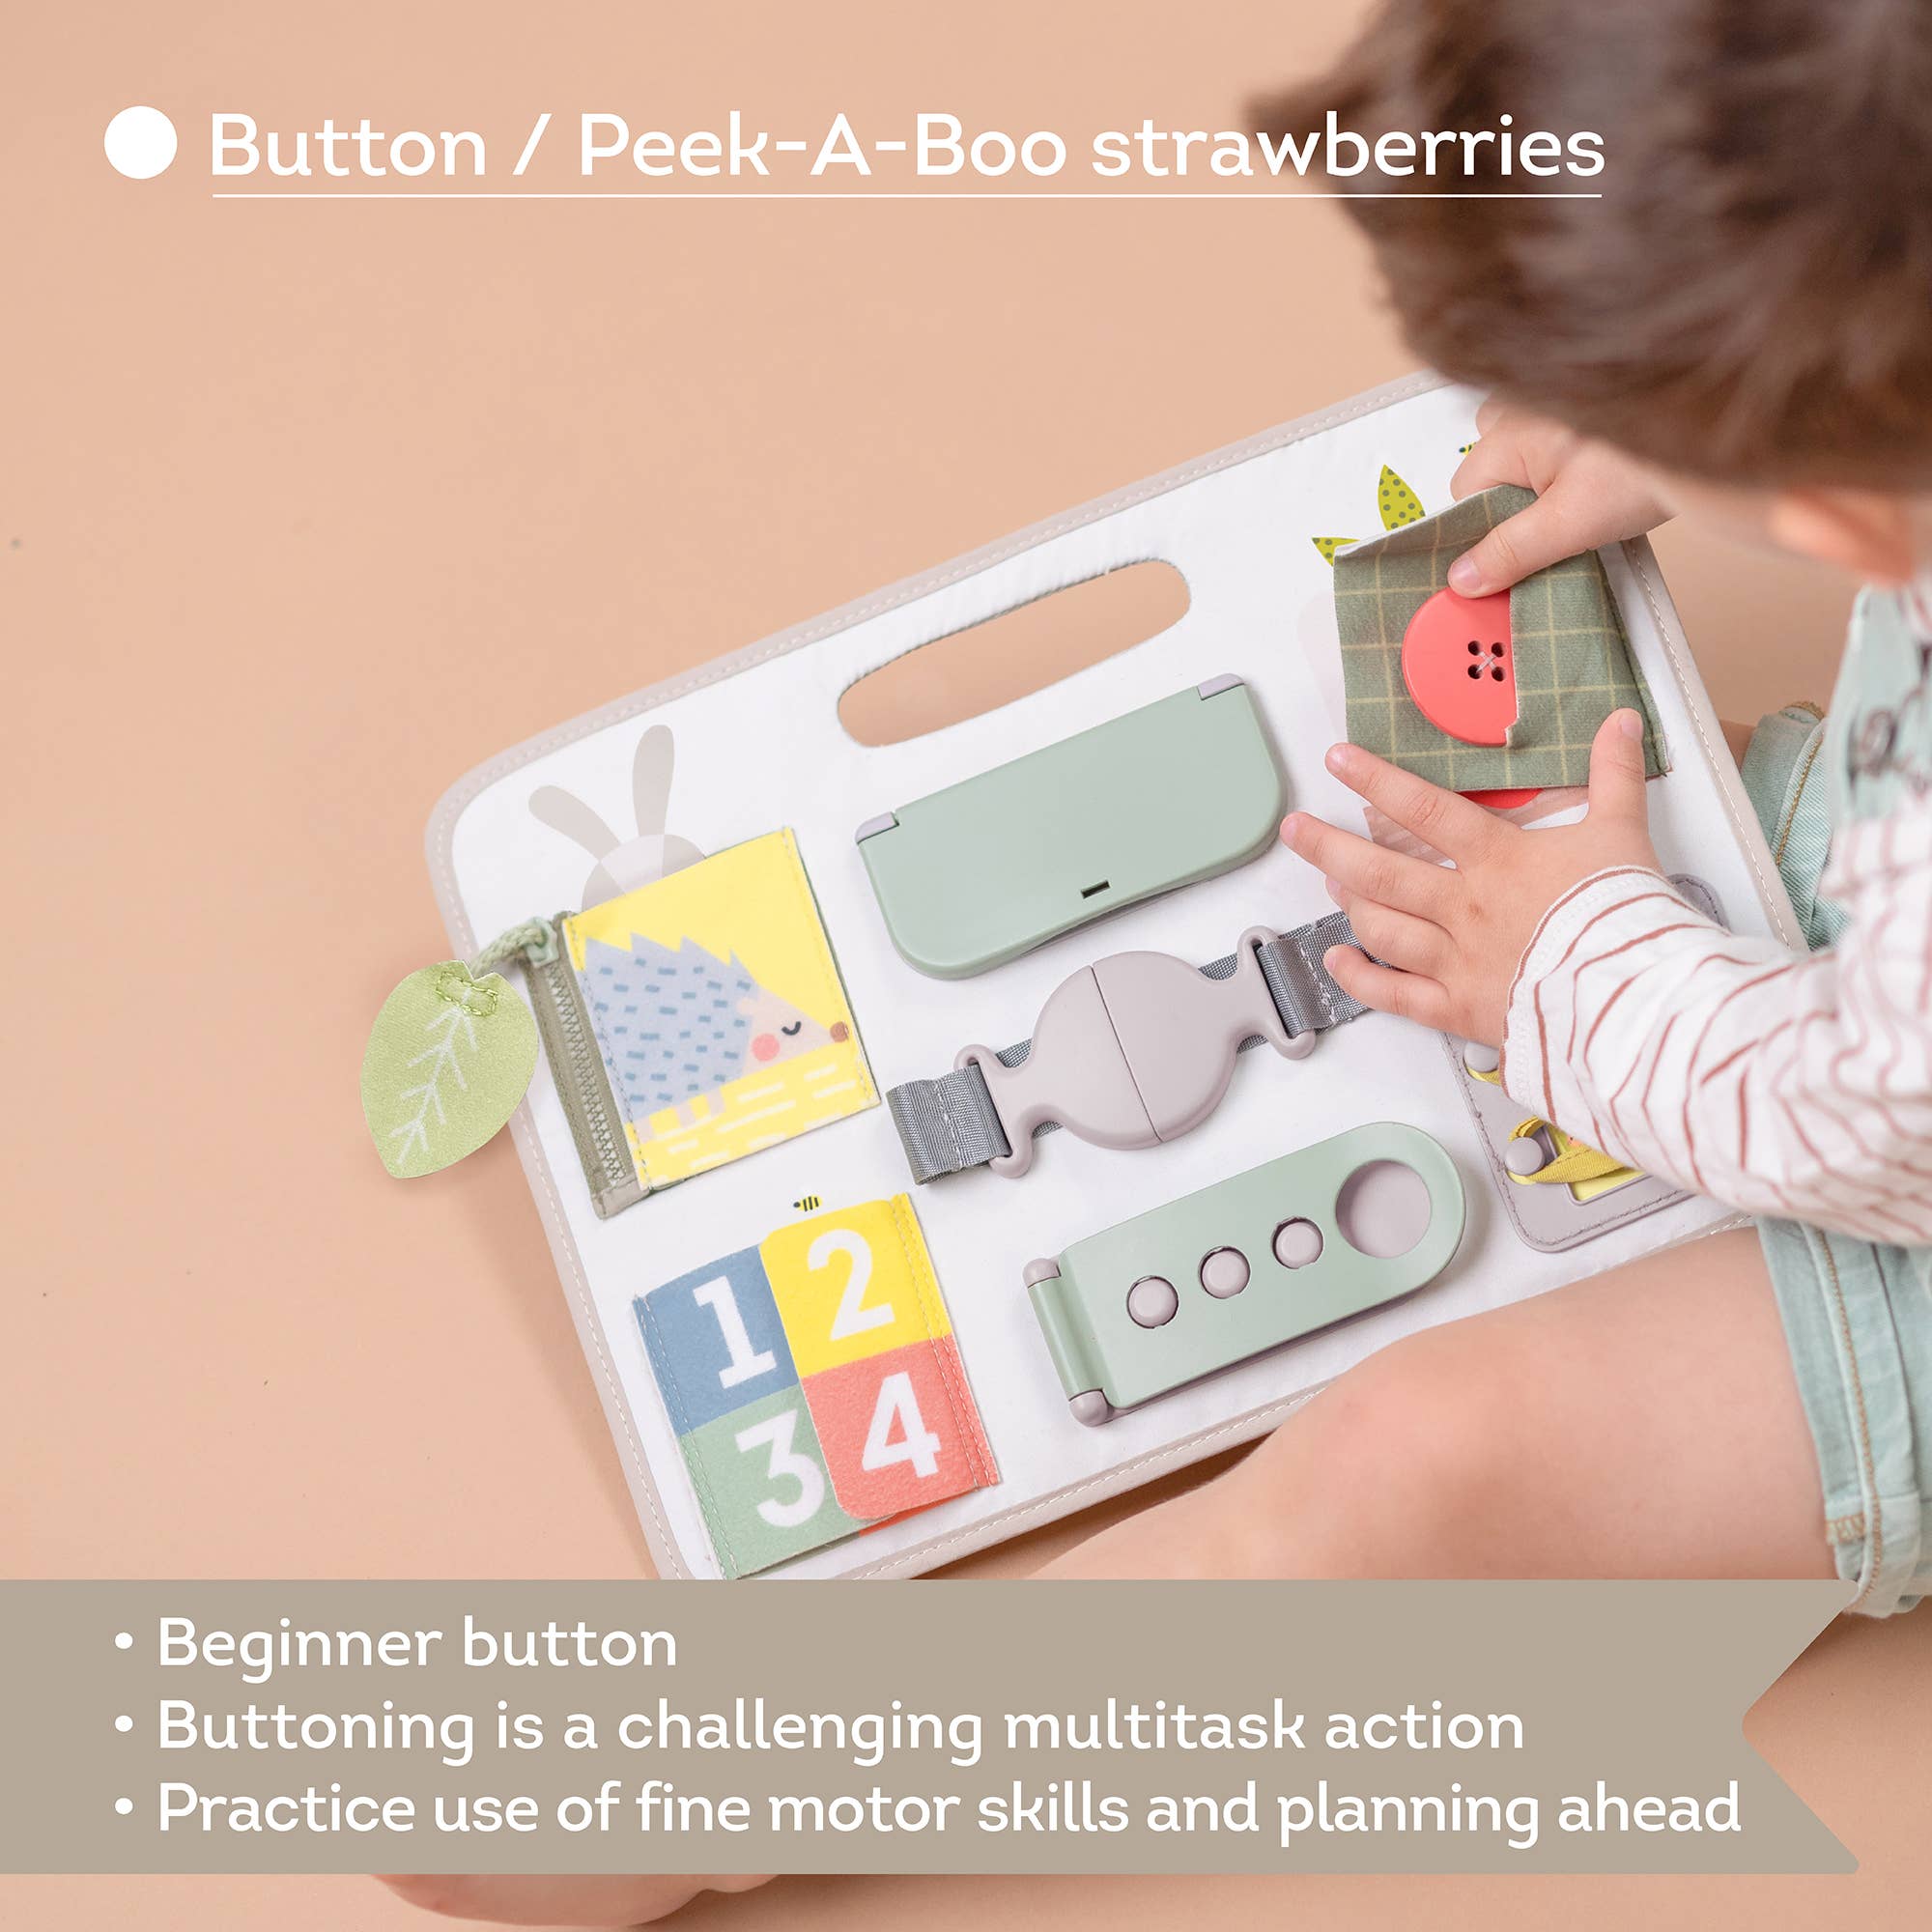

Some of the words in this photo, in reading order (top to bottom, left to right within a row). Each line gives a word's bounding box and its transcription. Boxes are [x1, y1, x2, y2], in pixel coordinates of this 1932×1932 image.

[693, 1275, 777, 1389] 1
[807, 1228, 895, 1342] 2
[735, 1408, 825, 1527] 3
[862, 1371, 941, 1479] 4
